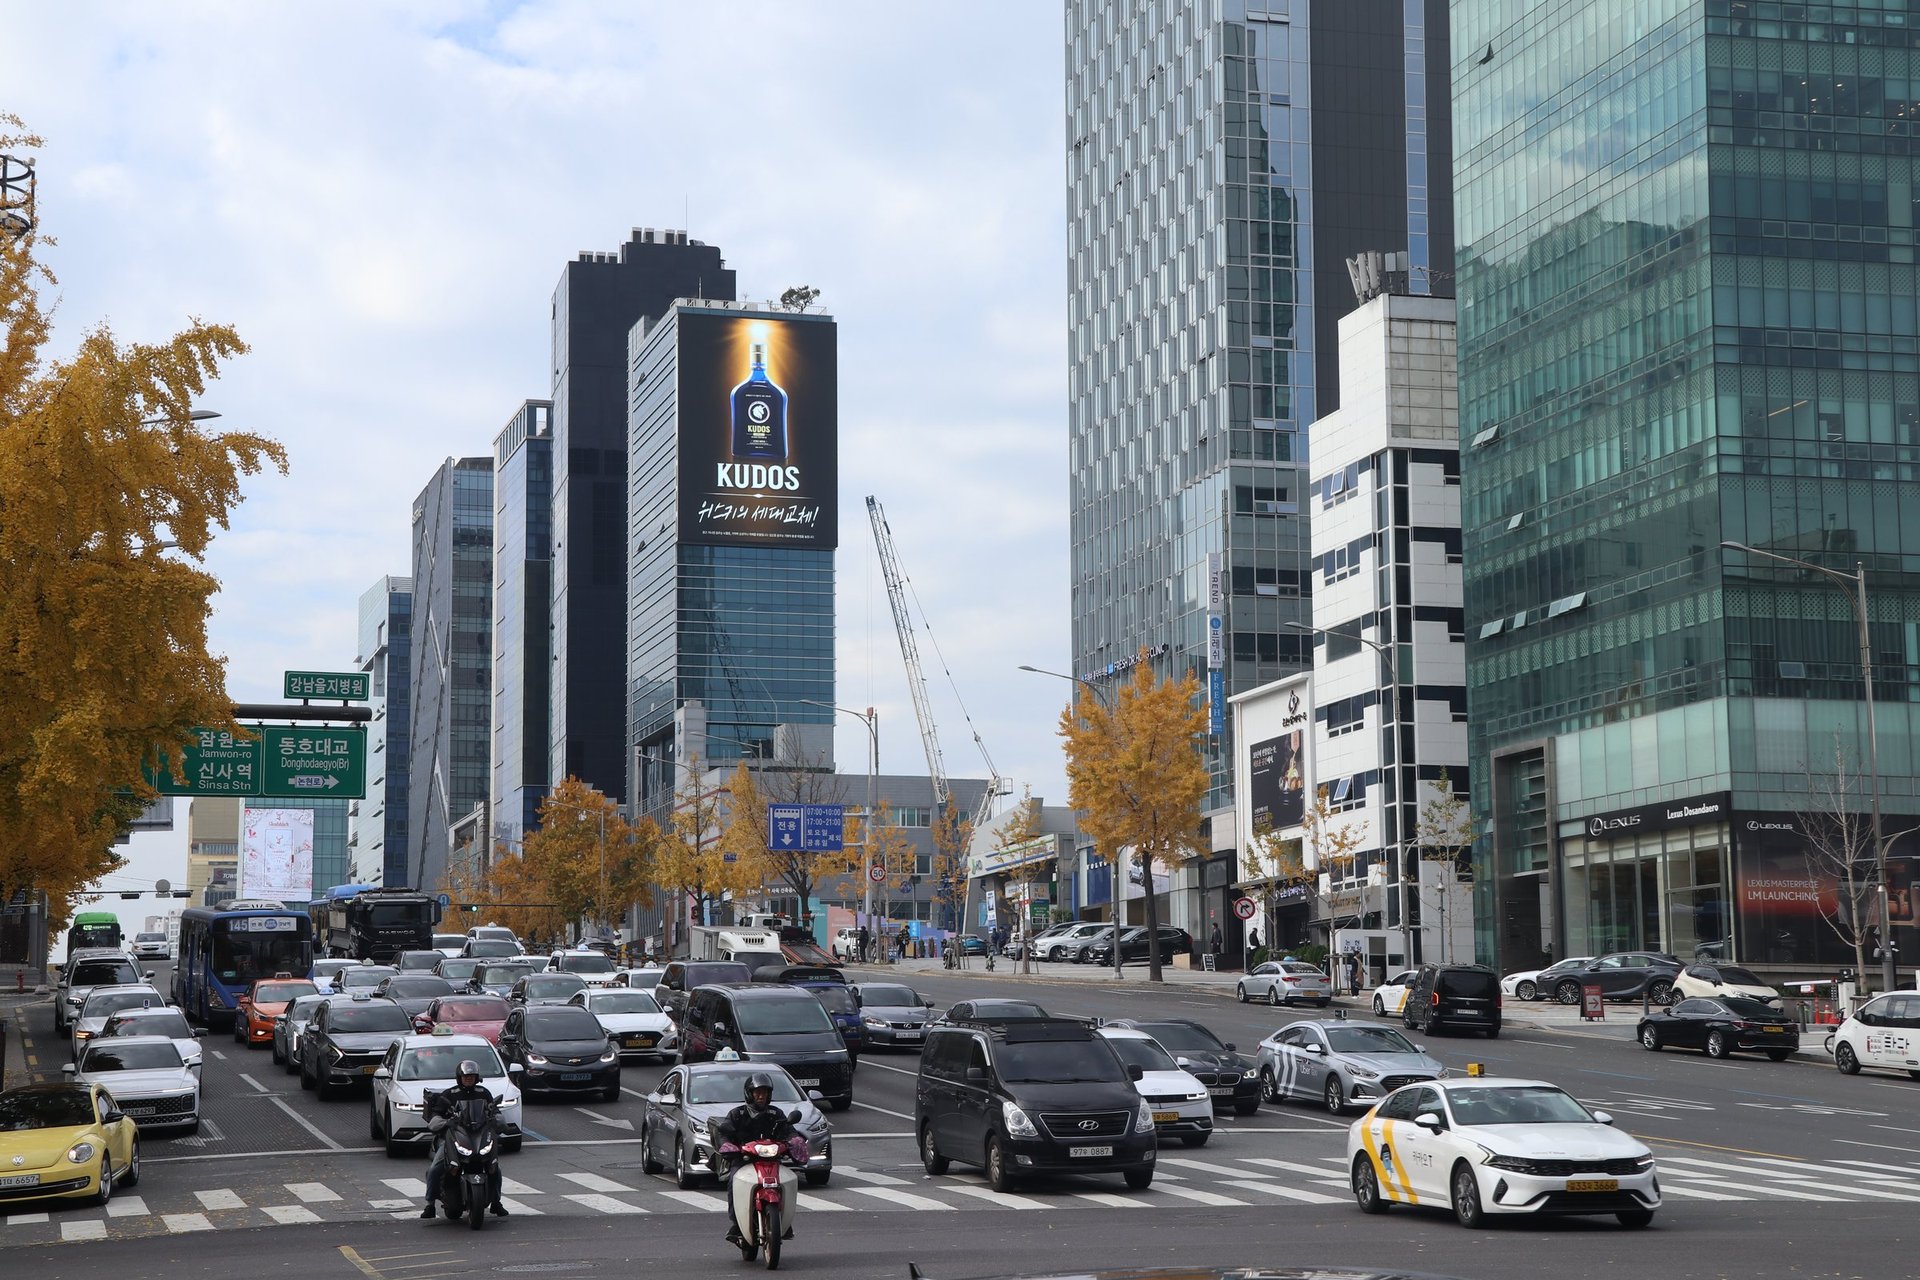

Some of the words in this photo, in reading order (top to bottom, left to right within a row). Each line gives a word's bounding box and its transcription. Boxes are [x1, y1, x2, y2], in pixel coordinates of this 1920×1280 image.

[747, 424, 771, 433] KUDOS
[716, 462, 800, 491] KUDOS
[698, 500, 749, 523] 위스키의
[751, 505, 820, 528] 세대교체!
[1211, 629, 1220, 661] 프레쉬
[290, 677, 363, 695] 강남을지병원
[1213, 673, 1221, 717] FRESH
[279, 737, 350, 756] 동호대교
[199, 748, 252, 759] Jamwon-ro
[281, 757, 350, 772] Donghodaegyo(Br)
[198, 762, 252, 780] 신사역
[198, 779, 230, 790] Sinsa
[232, 780, 251, 790] Stn
[298, 777, 321, 787] 논현로
[1603, 815, 1641, 830] LEXUS
[1667, 809, 1684, 820] Lexus
[1684, 802, 1719, 817] Dosandaero
[777, 821, 797, 831] 전용
[807, 828, 828, 837] 토요일
[873, 869, 883, 878] 50
[1747, 880, 1770, 888] LEXUS
[1771, 880, 1819, 889] MASTERPIECE
[1748, 890, 1761, 900] LM
[229, 919, 248, 931] 145
[1090, 1147, 1110, 1156] 0887
[15, 1176, 36, 1185] 6657
[1593, 1181, 1616, 1190] 3666
